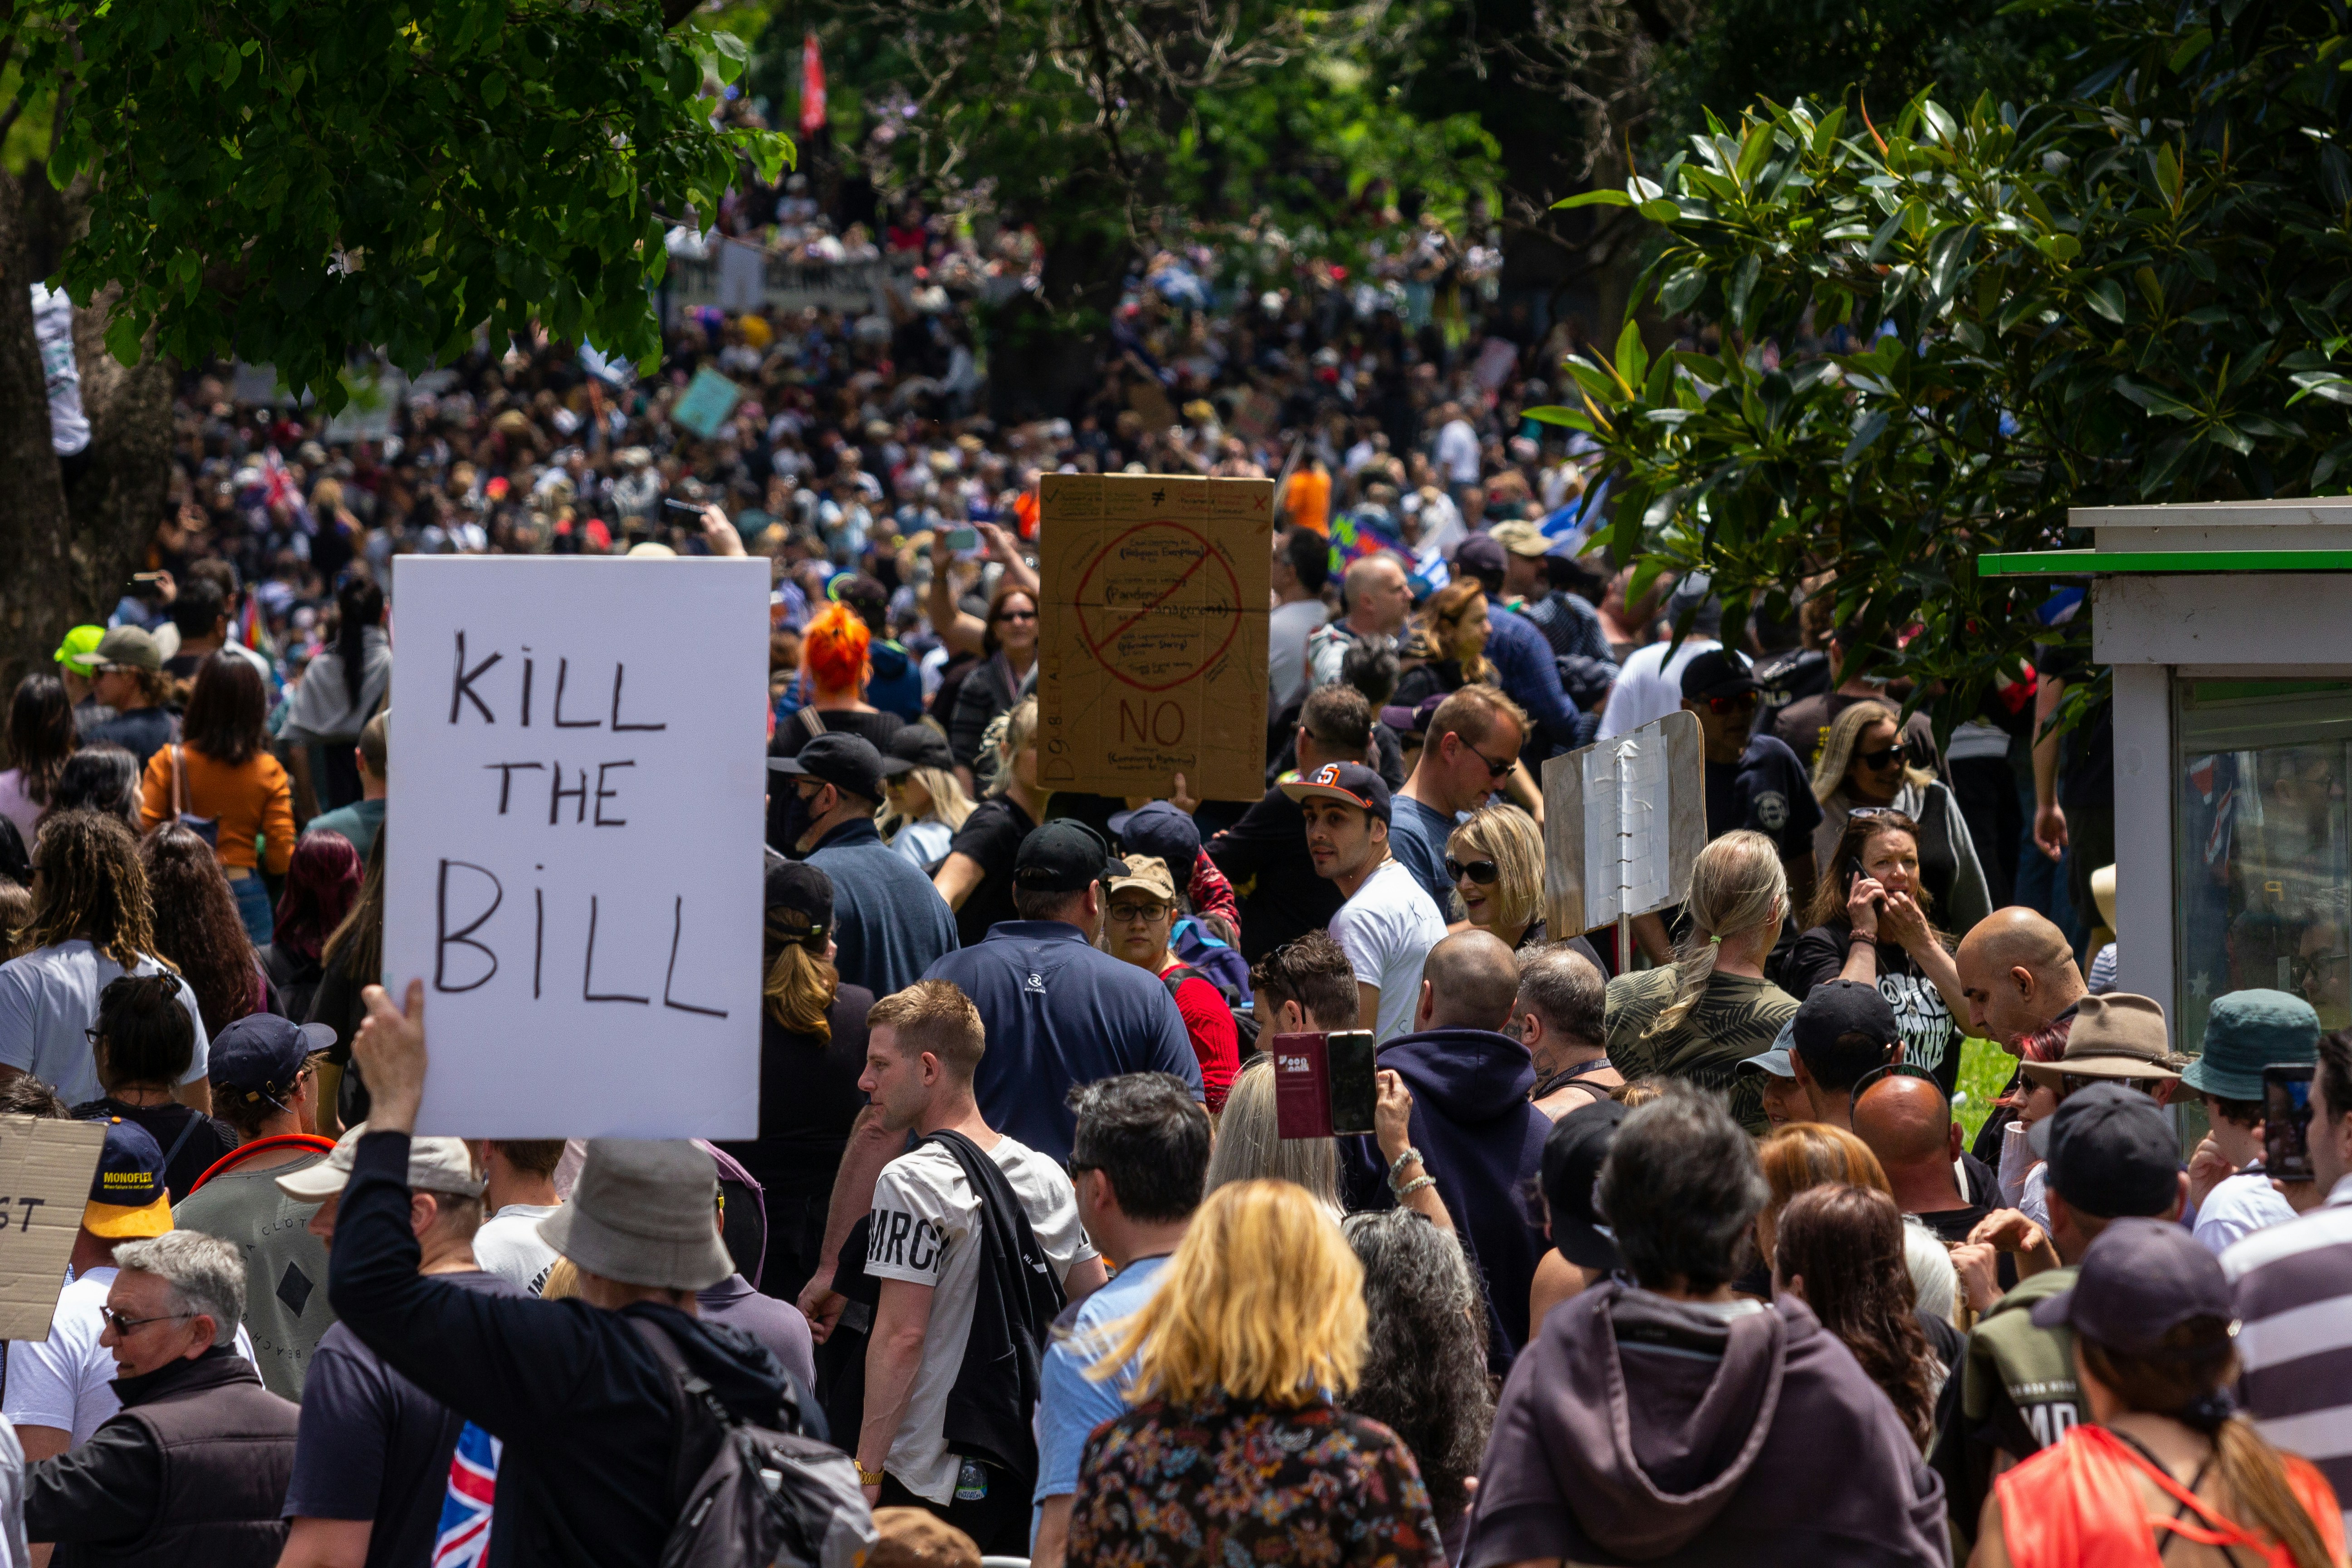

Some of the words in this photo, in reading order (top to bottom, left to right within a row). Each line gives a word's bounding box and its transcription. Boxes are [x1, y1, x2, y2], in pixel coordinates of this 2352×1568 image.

[1120, 698, 1185, 746] NO
[484, 760, 634, 826] THE
[103, 1172, 152, 1183] MONOFLEX
[261, 1218, 307, 1236] CLOT
